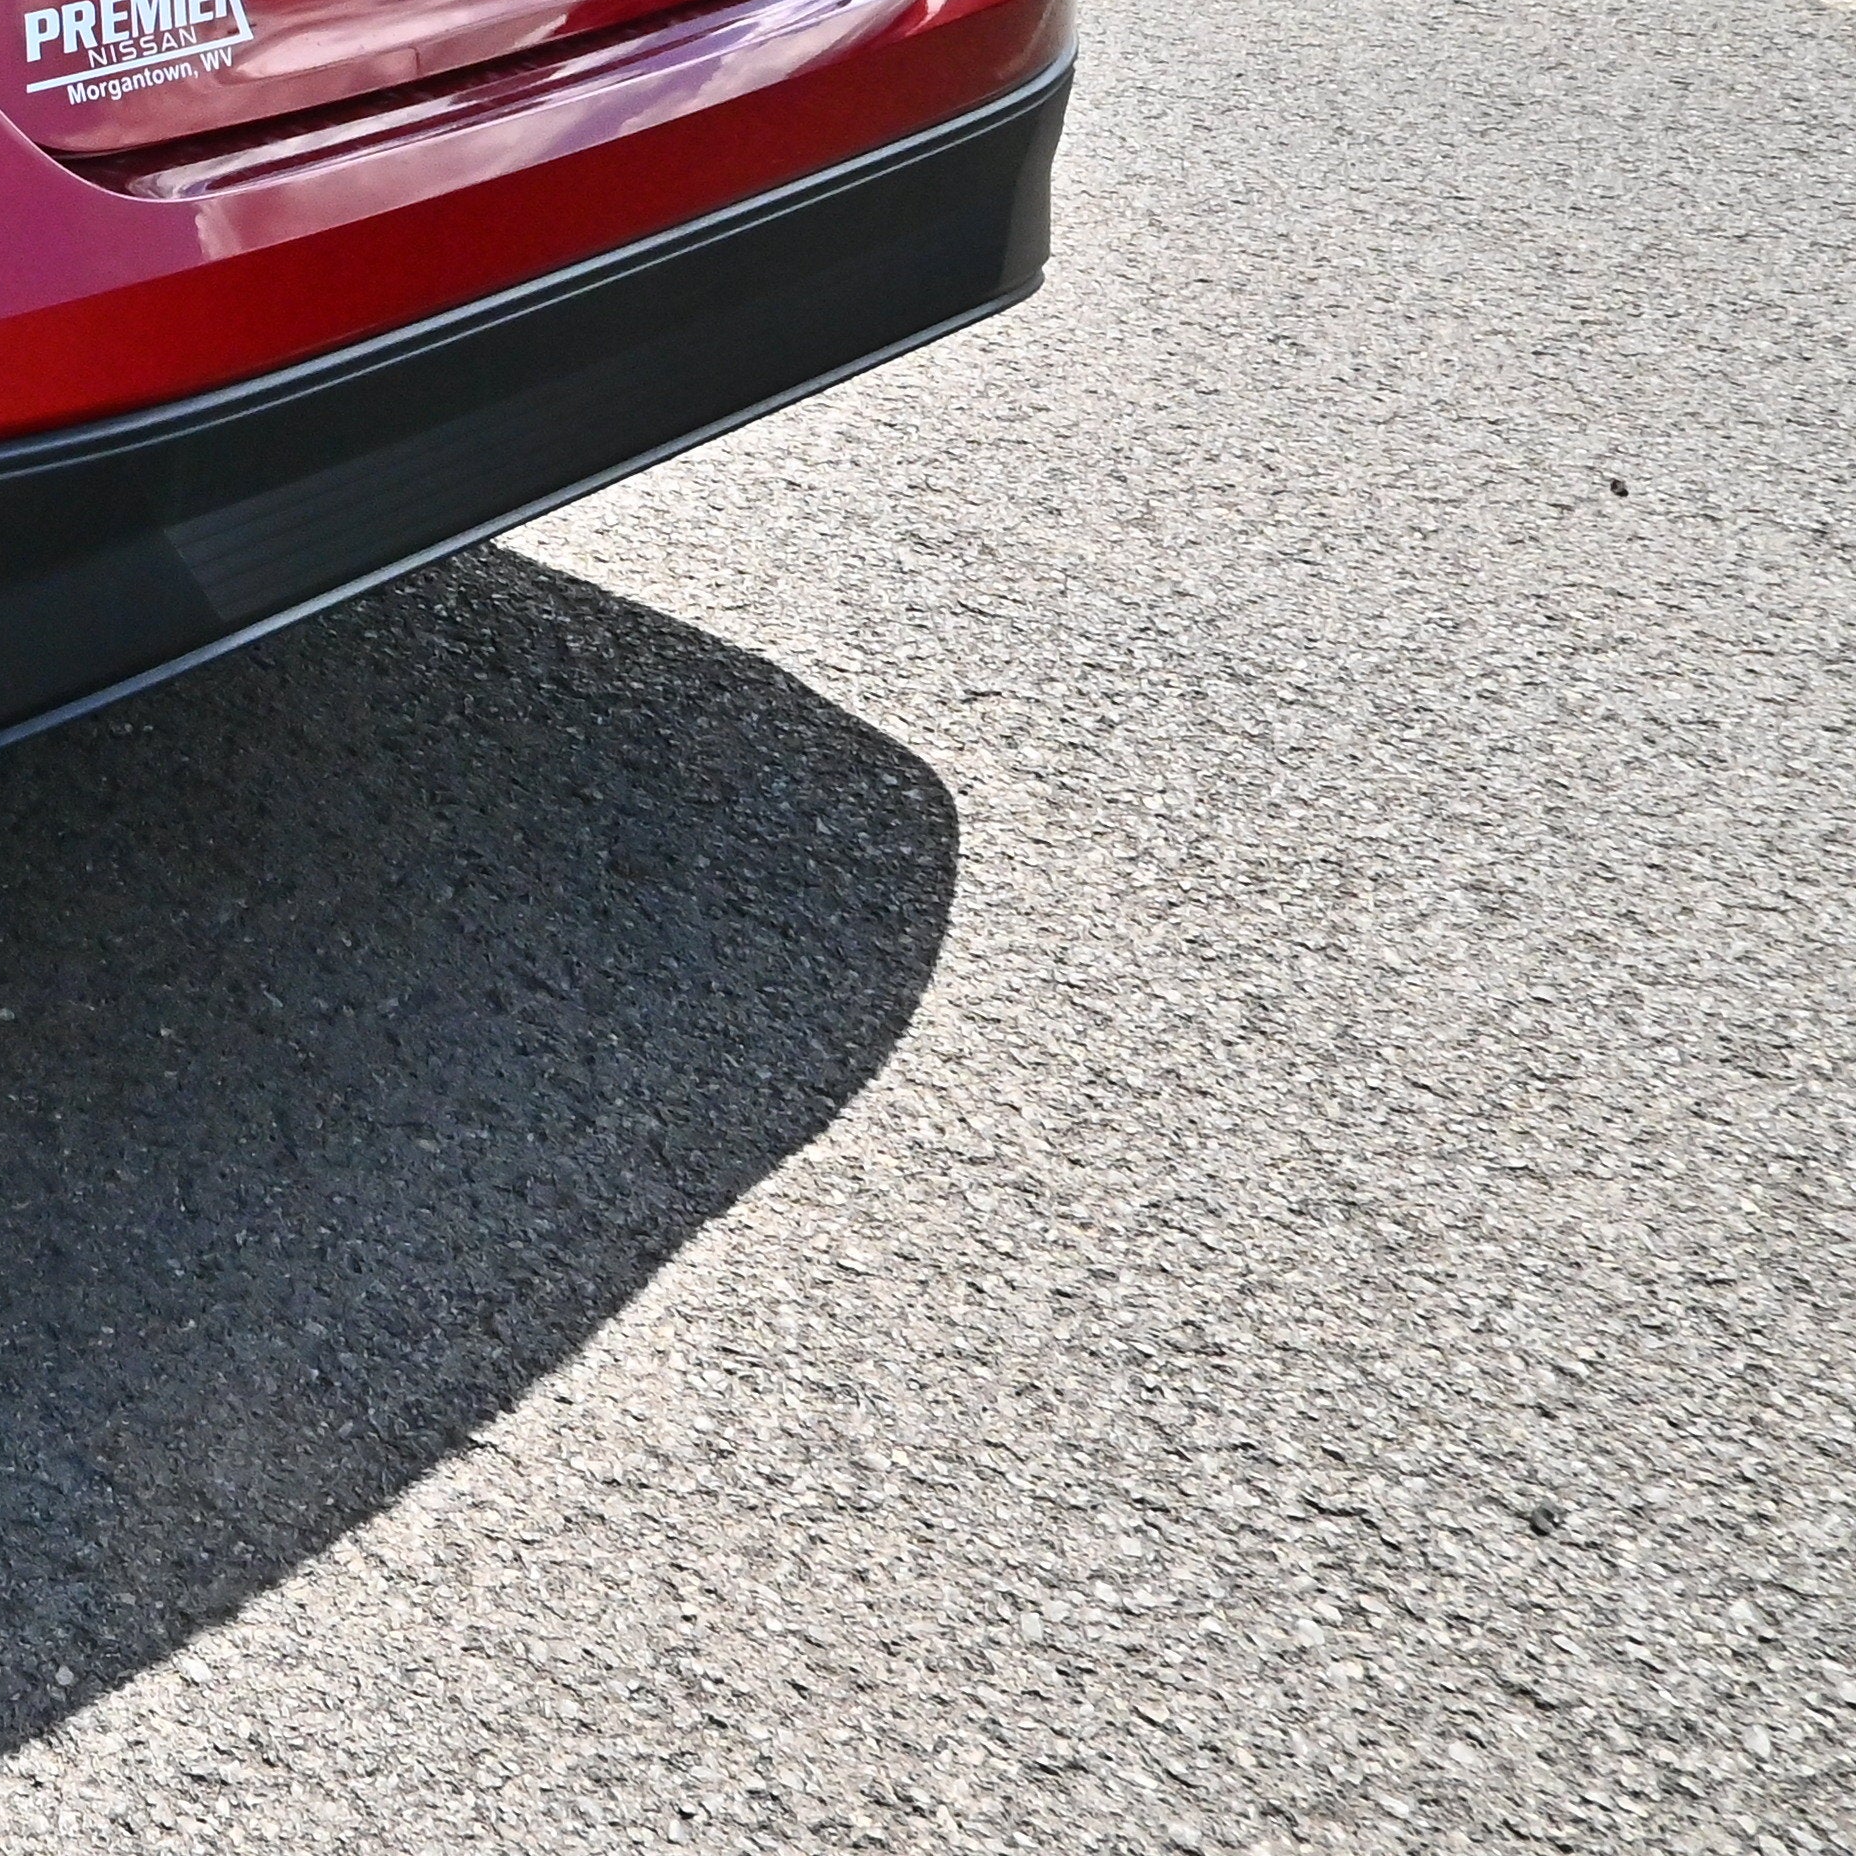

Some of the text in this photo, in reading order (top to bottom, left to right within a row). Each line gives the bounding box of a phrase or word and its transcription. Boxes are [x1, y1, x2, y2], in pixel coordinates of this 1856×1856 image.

[87, 25, 197, 69] NISSAN
[67, 47, 233, 106] Morgantown, WV
